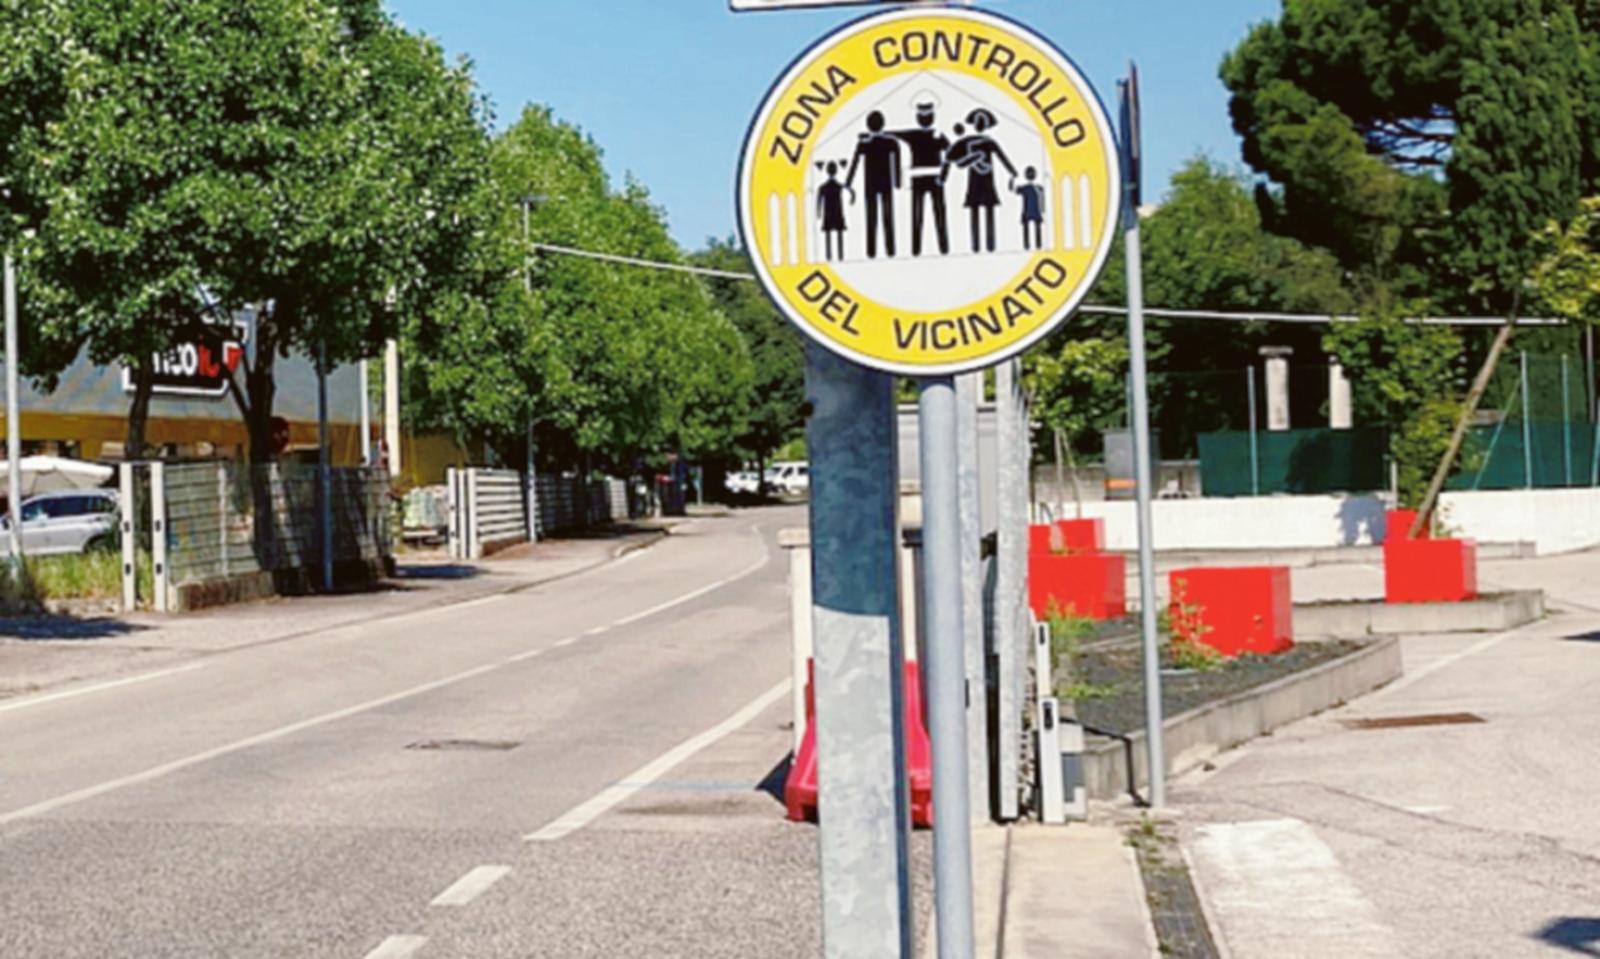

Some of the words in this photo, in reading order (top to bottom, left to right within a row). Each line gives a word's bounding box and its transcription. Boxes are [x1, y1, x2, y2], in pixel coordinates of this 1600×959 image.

[769, 64, 857, 164] ZONA
[873, 30, 1085, 148] CONTROLLO
[797, 270, 859, 336] DEL
[893, 257, 1067, 351] VICINATO
